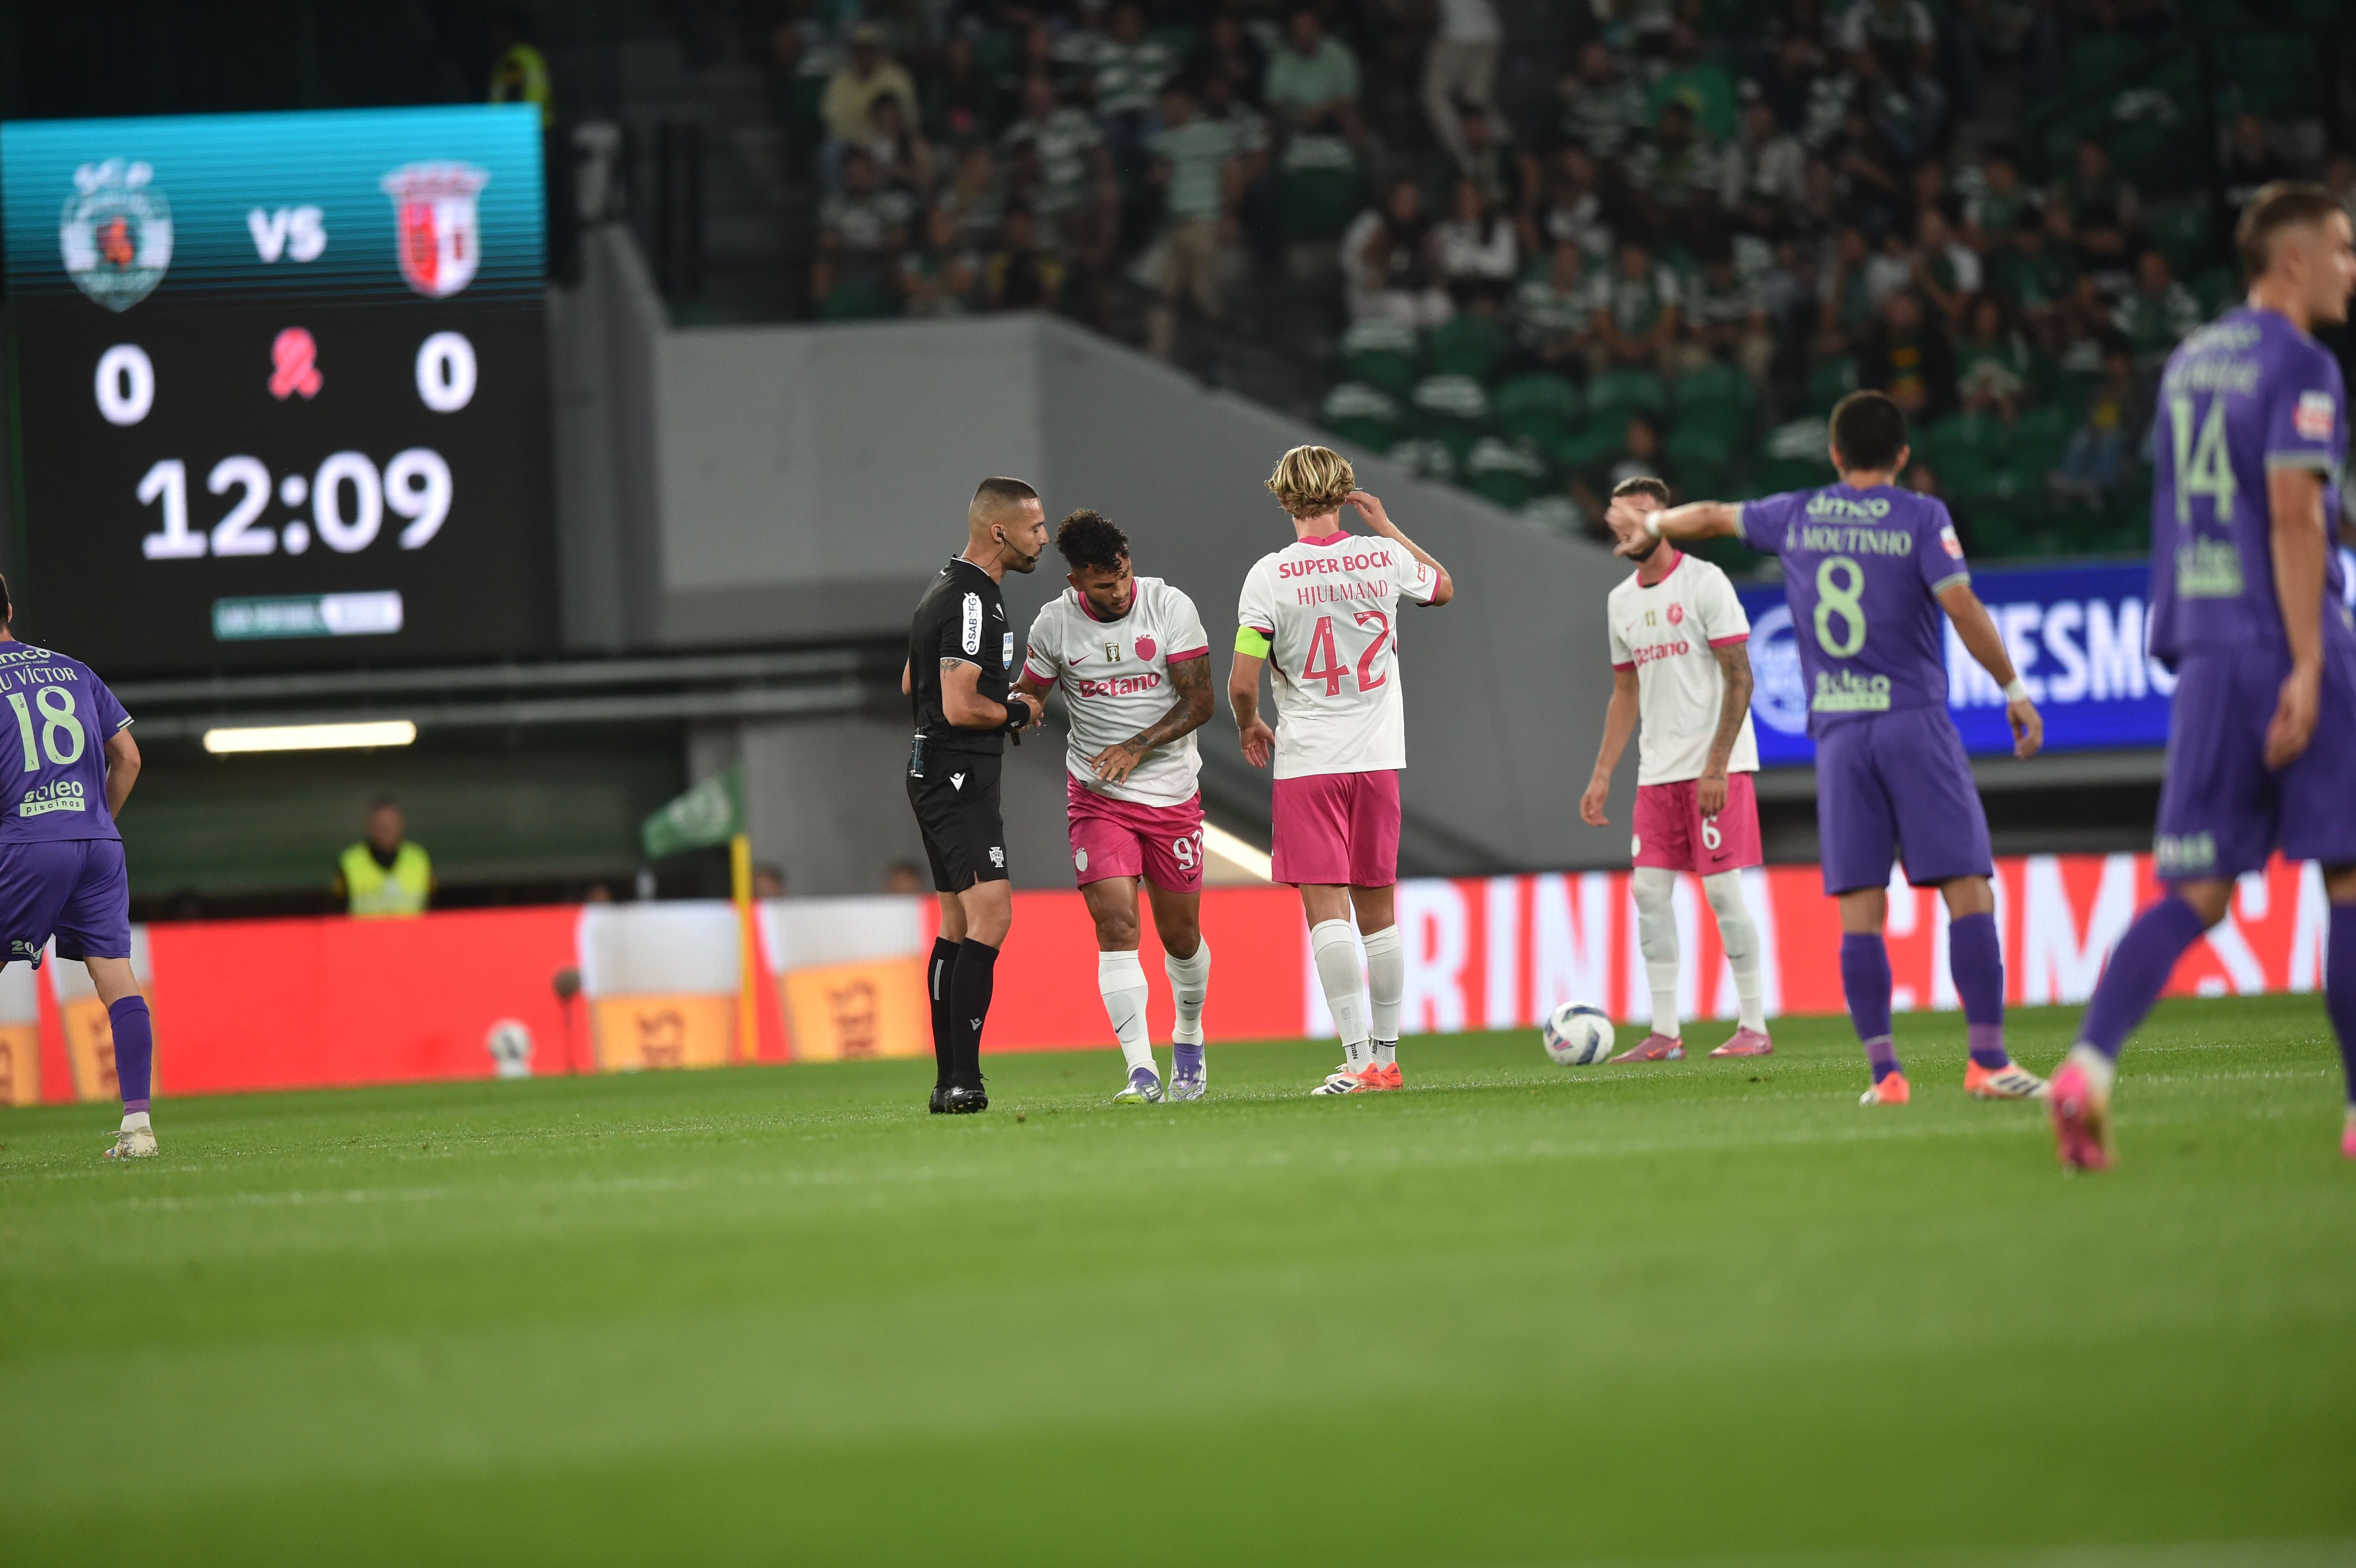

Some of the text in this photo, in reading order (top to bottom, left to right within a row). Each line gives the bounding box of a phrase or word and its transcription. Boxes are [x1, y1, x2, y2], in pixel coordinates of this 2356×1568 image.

[96, 344, 155, 426] 0
[415, 332, 476, 413] 0
[2171, 396, 2237, 523] 14
[137, 447, 453, 560] 12:09
[1279, 558, 1339, 578] SUPER
[1342, 550, 1393, 571] BOCK
[1297, 579, 1388, 608] HJULMAND
[1813, 555, 1866, 658] 8
[0, 649, 51, 664] mco
[1301, 610, 1390, 697] 42
[13, 665, 79, 686] VÍCTOR
[1079, 673, 1161, 697] Betano
[5, 686, 85, 773] 18
[24, 779, 84, 802] soleo
[26, 799, 80, 815] piscinas
[1702, 815, 1722, 850] 6
